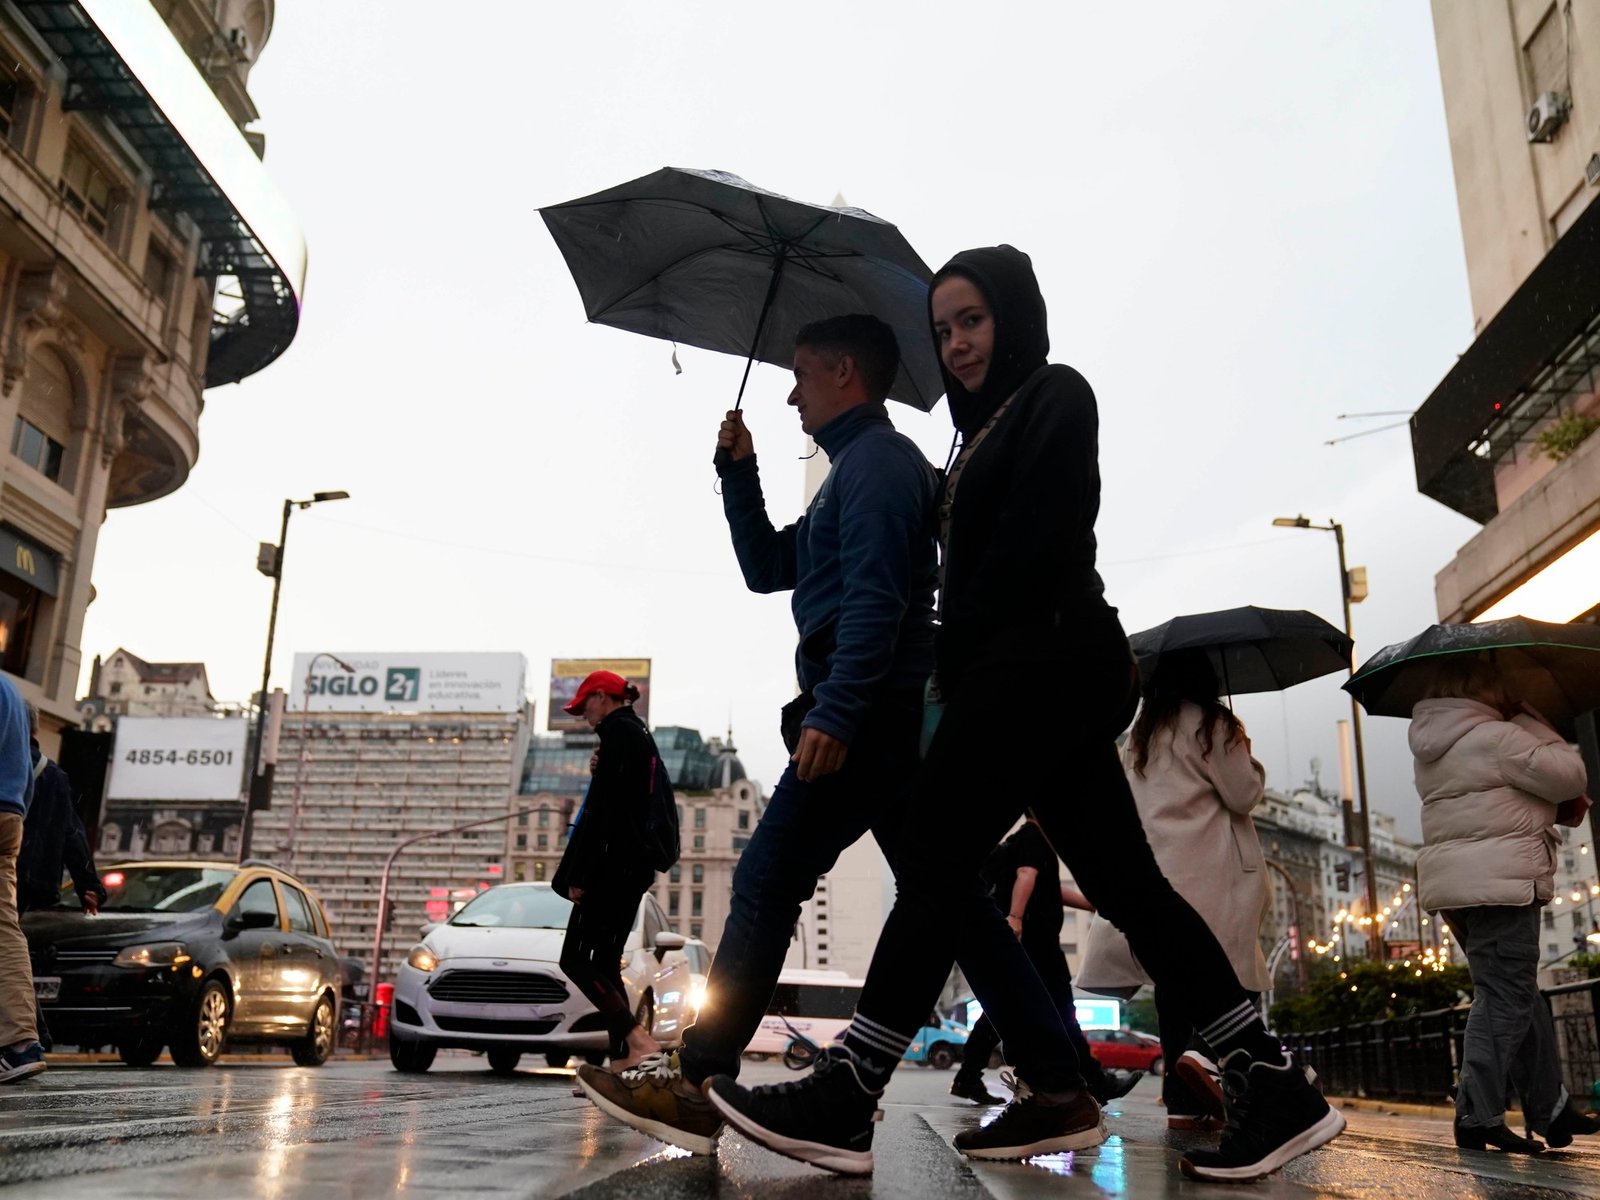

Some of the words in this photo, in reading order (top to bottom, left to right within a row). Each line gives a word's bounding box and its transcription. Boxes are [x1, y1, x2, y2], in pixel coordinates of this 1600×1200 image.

[304, 675, 379, 697] SIGLO
[388, 672, 415, 700] 21
[428, 681, 442, 689] en
[125, 749, 234, 766] 4854-6501
